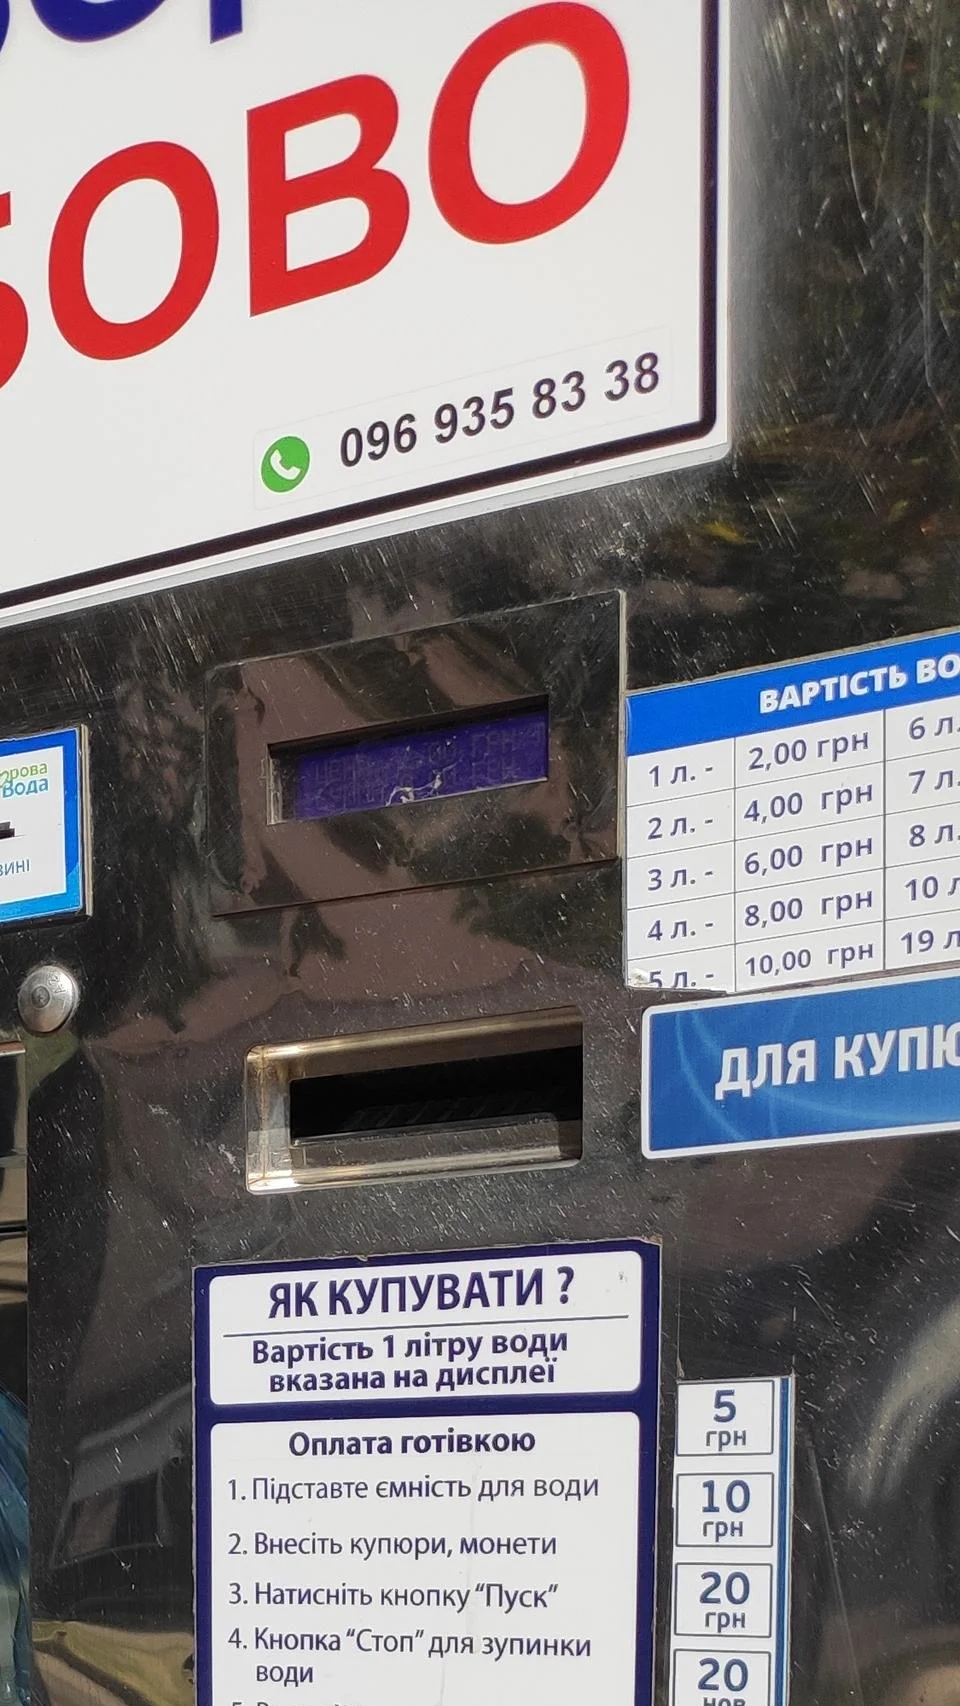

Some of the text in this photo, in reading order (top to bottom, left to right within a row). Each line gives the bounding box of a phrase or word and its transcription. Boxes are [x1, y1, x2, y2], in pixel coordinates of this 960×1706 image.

[340, 351, 660, 468] 096 935 83 38
[756, 656, 908, 714] ВАРТІСТЬ
[649, 716, 926, 787] 1 2,00 грн 6
[647, 769, 926, 840] 2 4,00 грн 7
[647, 824, 926, 891] 3 6,00 грн 8
[647, 875, 939, 942] 4 8,00 грн 10
[745, 929, 935, 977] 10,00 грн 19
[714, 1039, 816, 1101] ДЛЯ
[268, 1268, 543, 1319] ЯК КУПУВАТИ
[252, 1331, 568, 1370] Вартість 1 літру води
[269, 1356, 558, 1393] вказана на дисплеї
[713, 1389, 737, 1423] 5
[289, 1427, 536, 1462] Оплата готівкою
[705, 1429, 747, 1452] грн
[252, 1477, 599, 1505] Підставте ємність для води
[702, 1479, 751, 1514] 10
[254, 1531, 557, 1560] Внесіть купюри, монети
[702, 1520, 744, 1543] грн
[255, 1582, 373, 1606] Натисніть
[380, 1588, 471, 1614] кнопку
[699, 1571, 750, 1605] 20
[704, 1611, 746, 1634] грн
[255, 1626, 341, 1652] Кнопка
[428, 1632, 474, 1657] для
[481, 1636, 591, 1662] зупинки
[256, 1665, 314, 1688] води
[697, 1657, 749, 1692] 20
